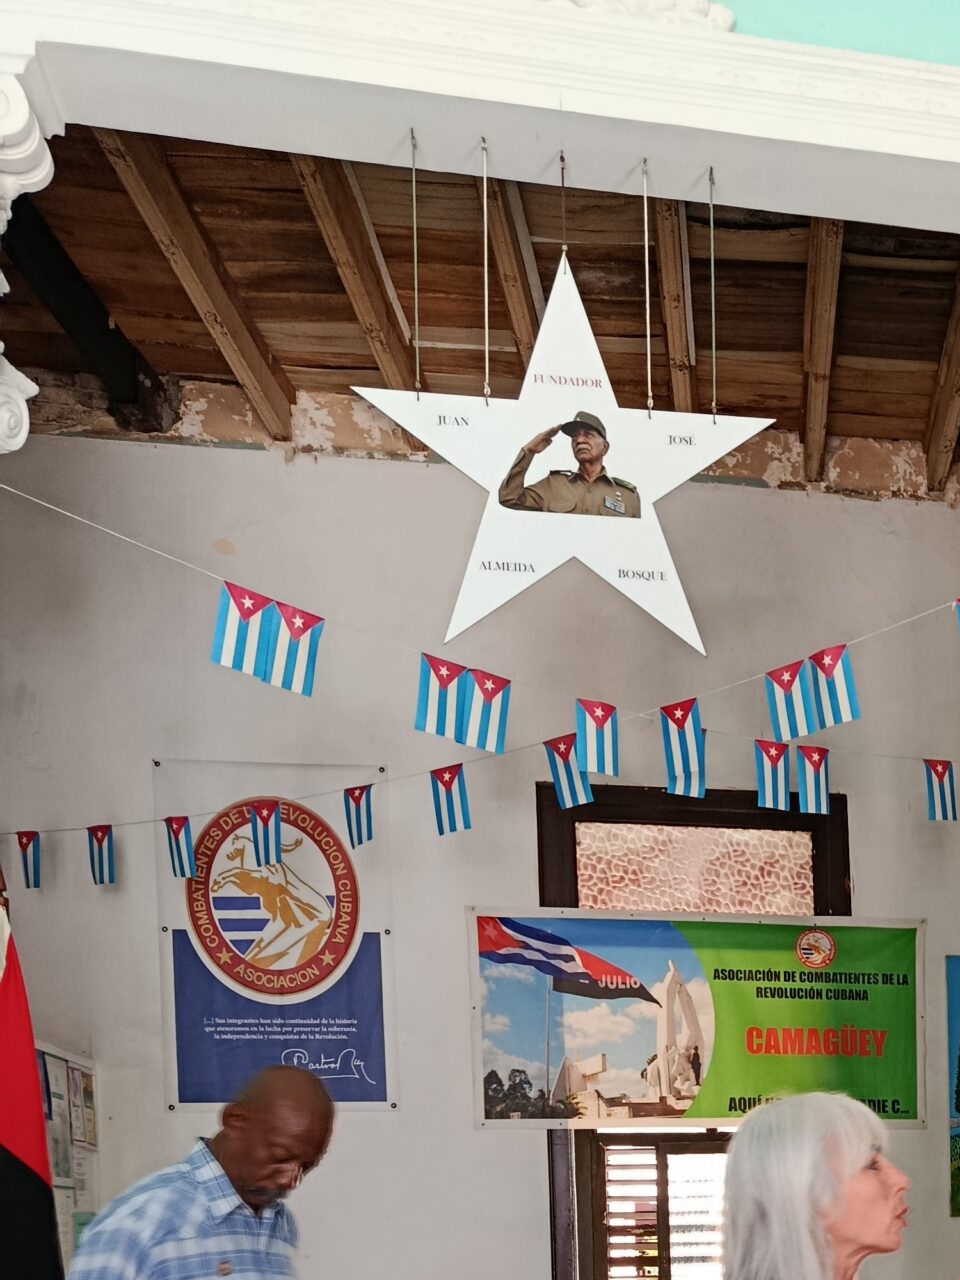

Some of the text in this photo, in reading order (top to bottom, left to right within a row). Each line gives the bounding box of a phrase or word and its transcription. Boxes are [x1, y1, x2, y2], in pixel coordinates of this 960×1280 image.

[533, 373, 603, 389] FUNDADOR
[436, 415, 470, 427] JUAN
[478, 561, 536, 573] ALMEIDA
[618, 568, 668, 582] BOSQUE
[219, 810, 243, 831] DE
[280, 804, 348, 876] EVOLUCION
[333, 879, 353, 945] CUBANA
[233, 963, 320, 988] ASOCIACION
[598, 974, 642, 989] JULIO
[713, 968, 909, 986] ASOCIACIÓN DE COMBATIENTES DE LA
[756, 986, 869, 1001] REVOLUCIÓN CUBANA
[745, 1024, 888, 1058] CAMAGÜEY
